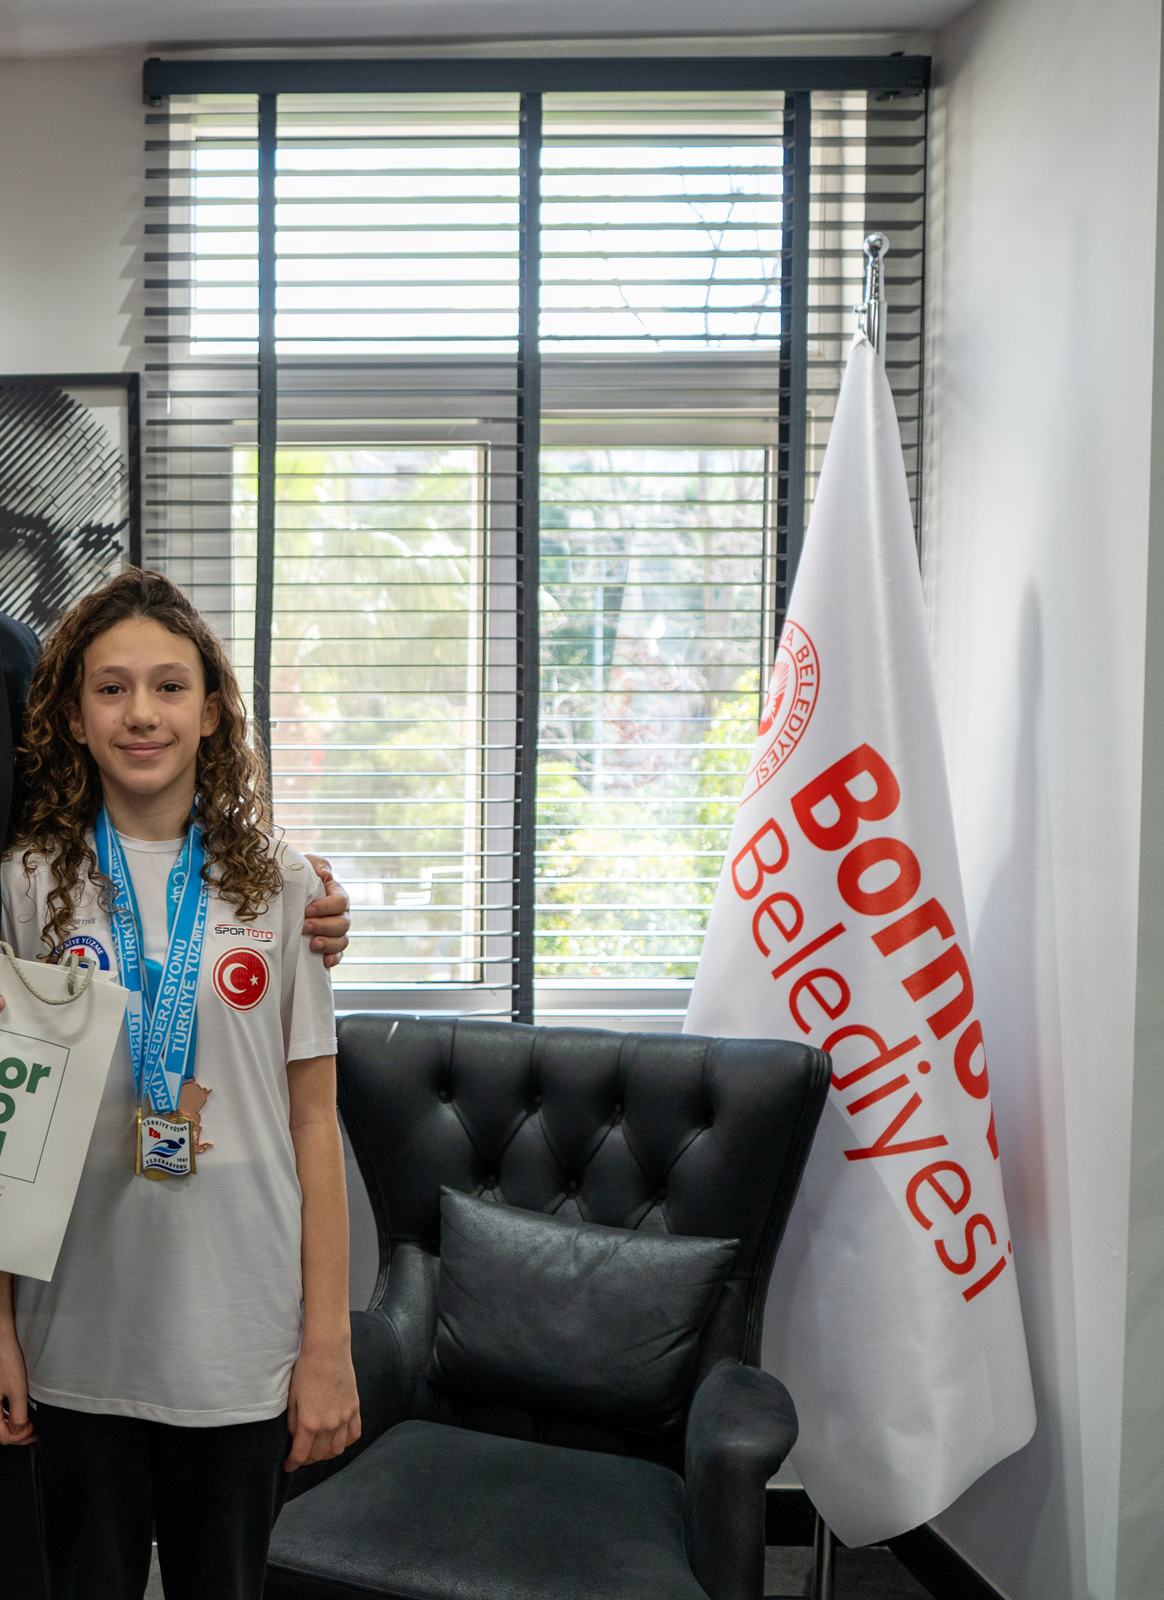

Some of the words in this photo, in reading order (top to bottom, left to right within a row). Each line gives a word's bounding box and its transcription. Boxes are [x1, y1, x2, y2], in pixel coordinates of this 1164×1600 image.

[82, 937, 104, 955] YÜZME
[116, 902, 138, 972] TÜRKİYE
[790, 742, 999, 1160] Borno
[147, 939, 187, 1065] FEDERASYONU
[171, 980, 195, 1053] TÜRKİYE
[731, 818, 1013, 1303] Belediyesi
[143, 1119, 169, 1129] TÜRKİYE
[146, 1158, 187, 1169] FEDERASYONU
